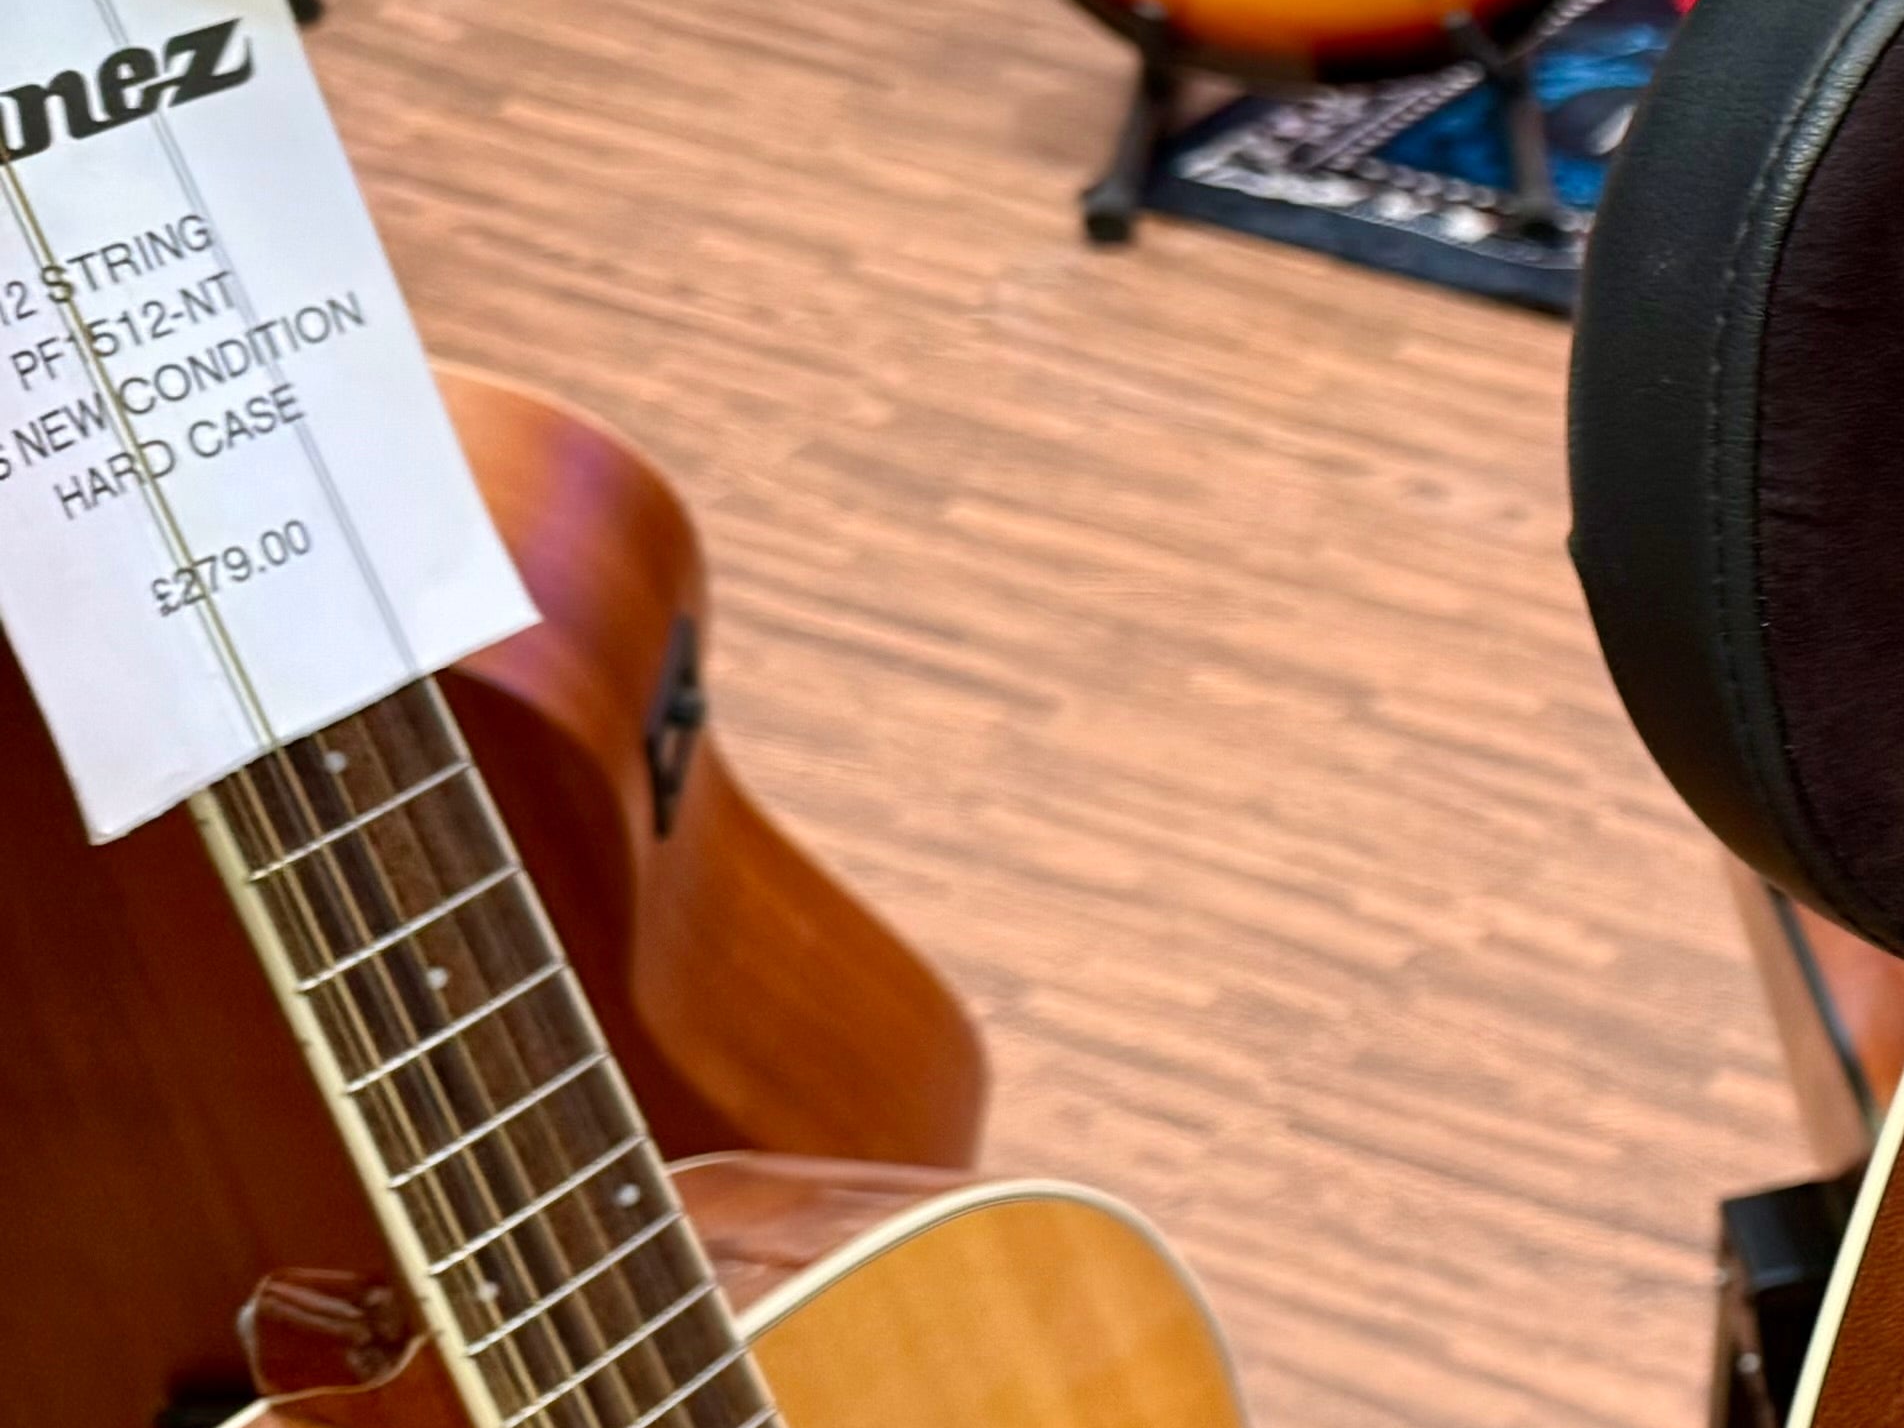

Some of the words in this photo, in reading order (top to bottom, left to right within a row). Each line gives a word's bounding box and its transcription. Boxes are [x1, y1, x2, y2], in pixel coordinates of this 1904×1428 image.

[0, 18, 254, 165] nez
[40, 215, 213, 303] STRING
[12, 392, 107, 466] NEW
[118, 290, 366, 415] CONDITION
[53, 439, 176, 520] HARD
[188, 383, 305, 459] CASE
[152, 520, 310, 617] £279.00
